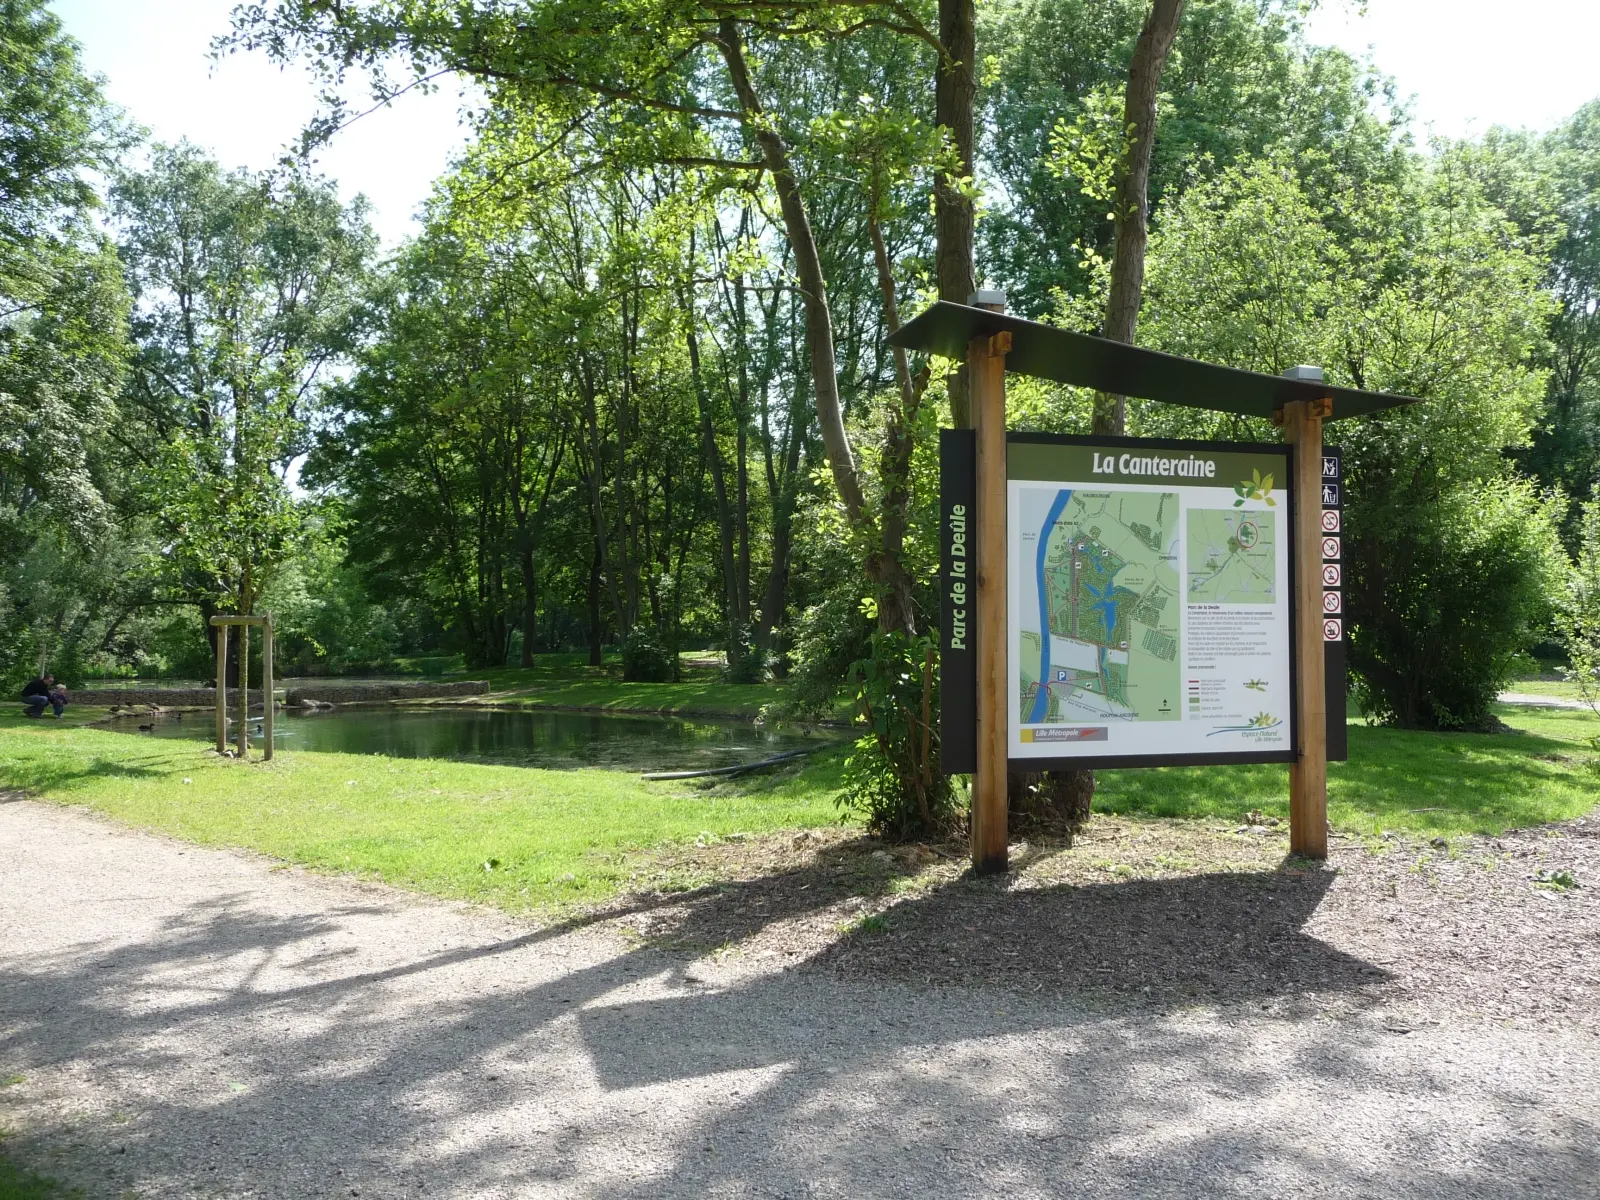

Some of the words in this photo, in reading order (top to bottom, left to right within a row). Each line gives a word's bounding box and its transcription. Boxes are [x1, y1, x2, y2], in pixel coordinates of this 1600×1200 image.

[1092, 453, 1115, 474] La
[1118, 454, 1216, 478] Canteraine
[948, 504, 966, 558] Deûle
[949, 561, 966, 578] la
[949, 582, 966, 605] de
[951, 608, 966, 650] Parc
[1058, 671, 1066, 680] P
[1035, 729, 1048, 737] Lille
[1048, 728, 1079, 738] Métropole
